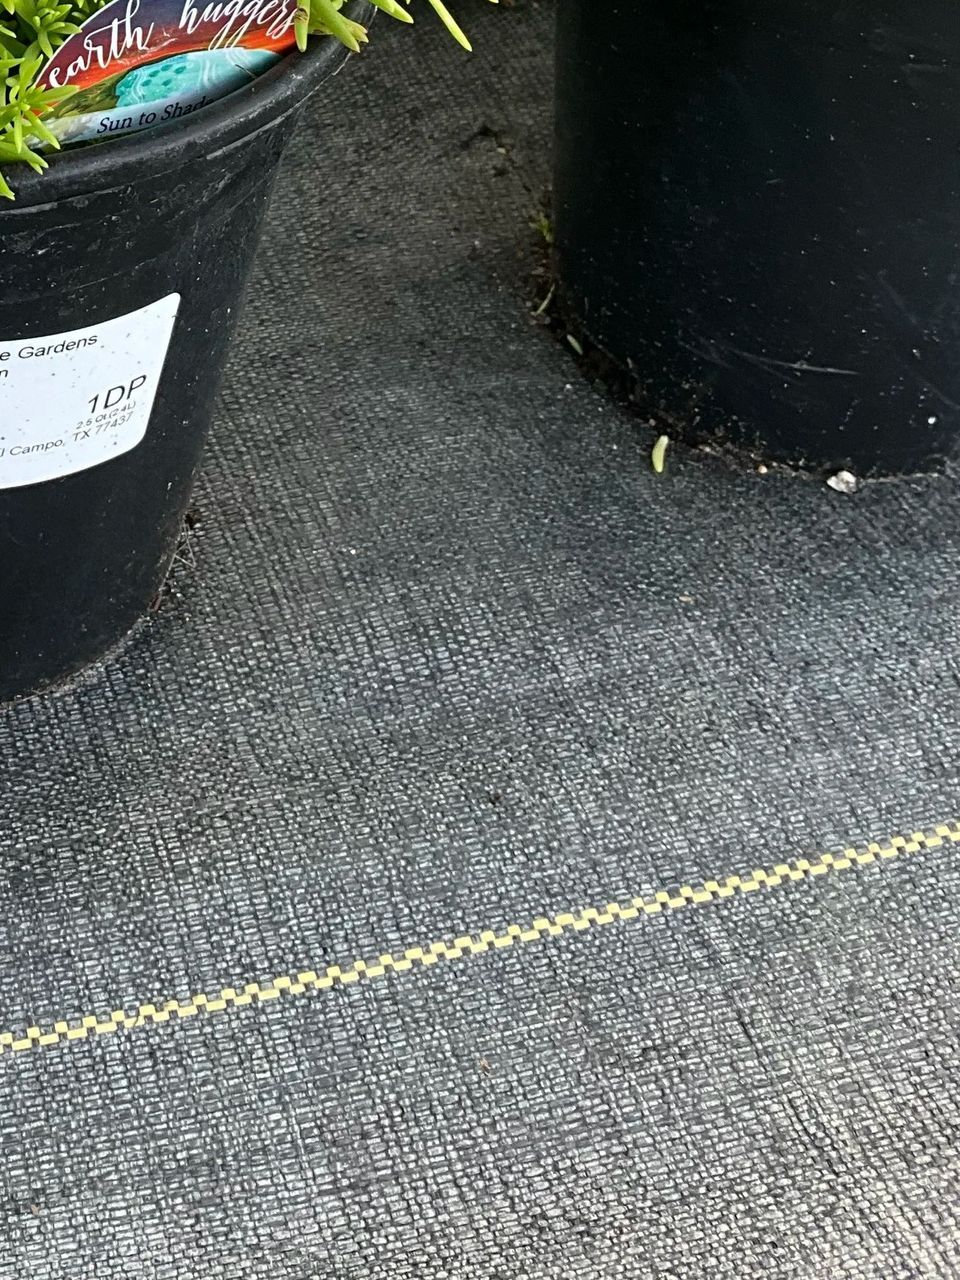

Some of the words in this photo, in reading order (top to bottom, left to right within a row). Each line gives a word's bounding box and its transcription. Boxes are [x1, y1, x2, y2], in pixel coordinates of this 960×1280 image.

[97, 117, 132, 134] Sun
[139, 111, 157, 127] to
[18, 334, 98, 360] Gardens
[88, 375, 147, 414] 1DP
[10, 438, 65, 456] Campo,
[72, 428, 91, 442] TX
[96, 410, 134, 435] 77437
